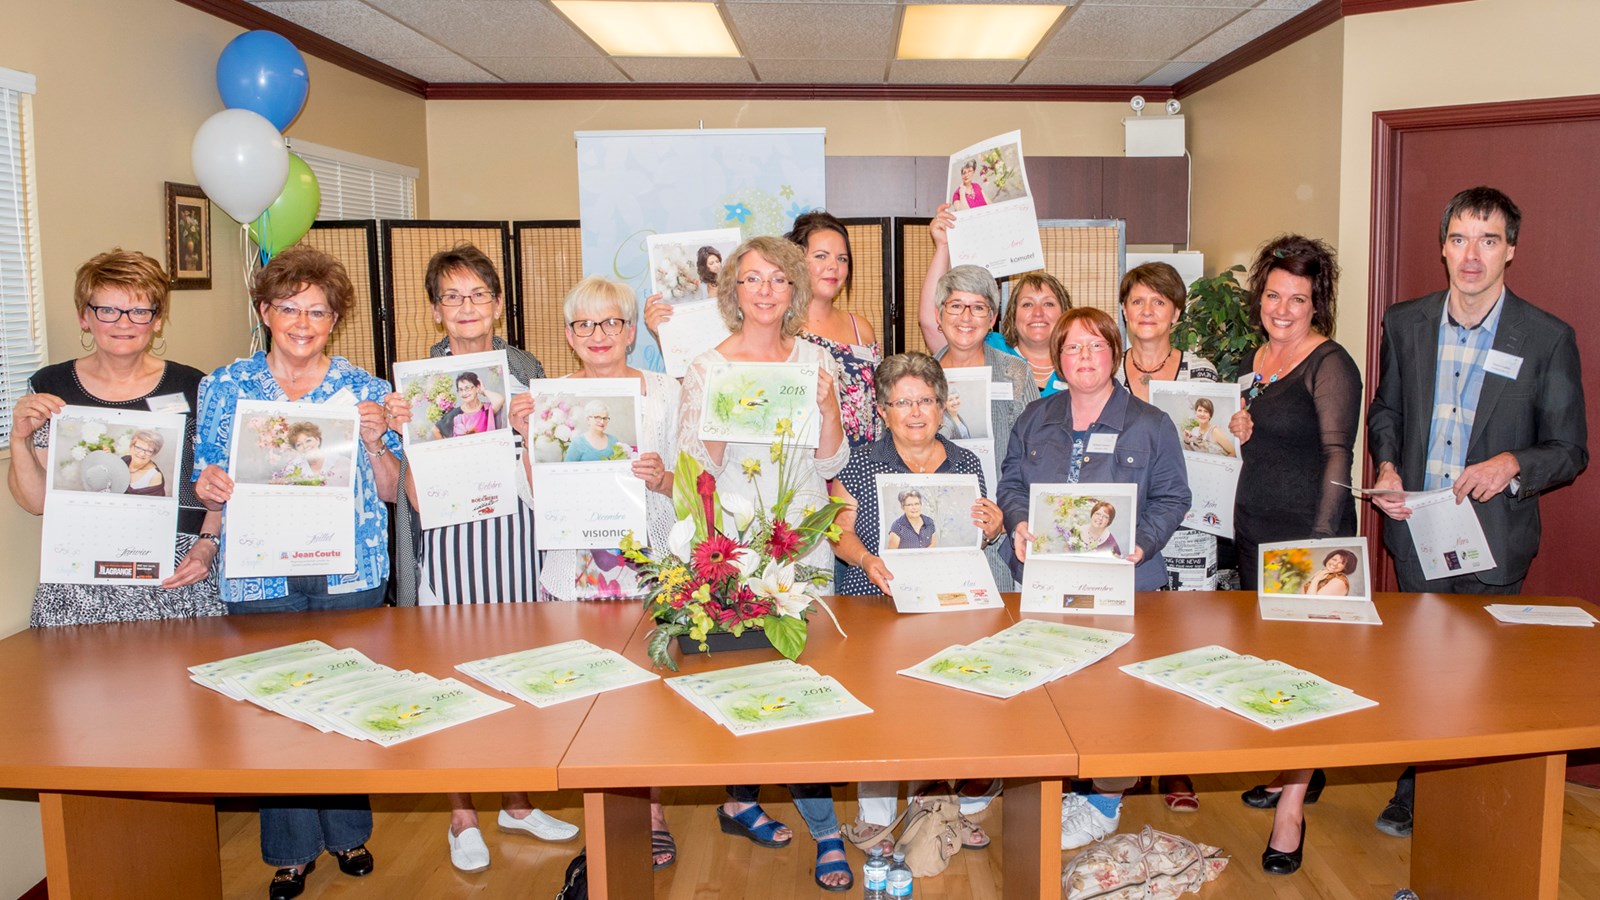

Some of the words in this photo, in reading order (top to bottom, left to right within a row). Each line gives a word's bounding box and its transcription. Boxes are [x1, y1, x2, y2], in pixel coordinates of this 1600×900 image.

[779, 386, 807, 395] 2018
[328, 659, 358, 671] 2018
[586, 658, 616, 669] 2018
[1292, 680, 1320, 690] 2018
[432, 689, 463, 702] 2018
[800, 686, 832, 696] 2018
